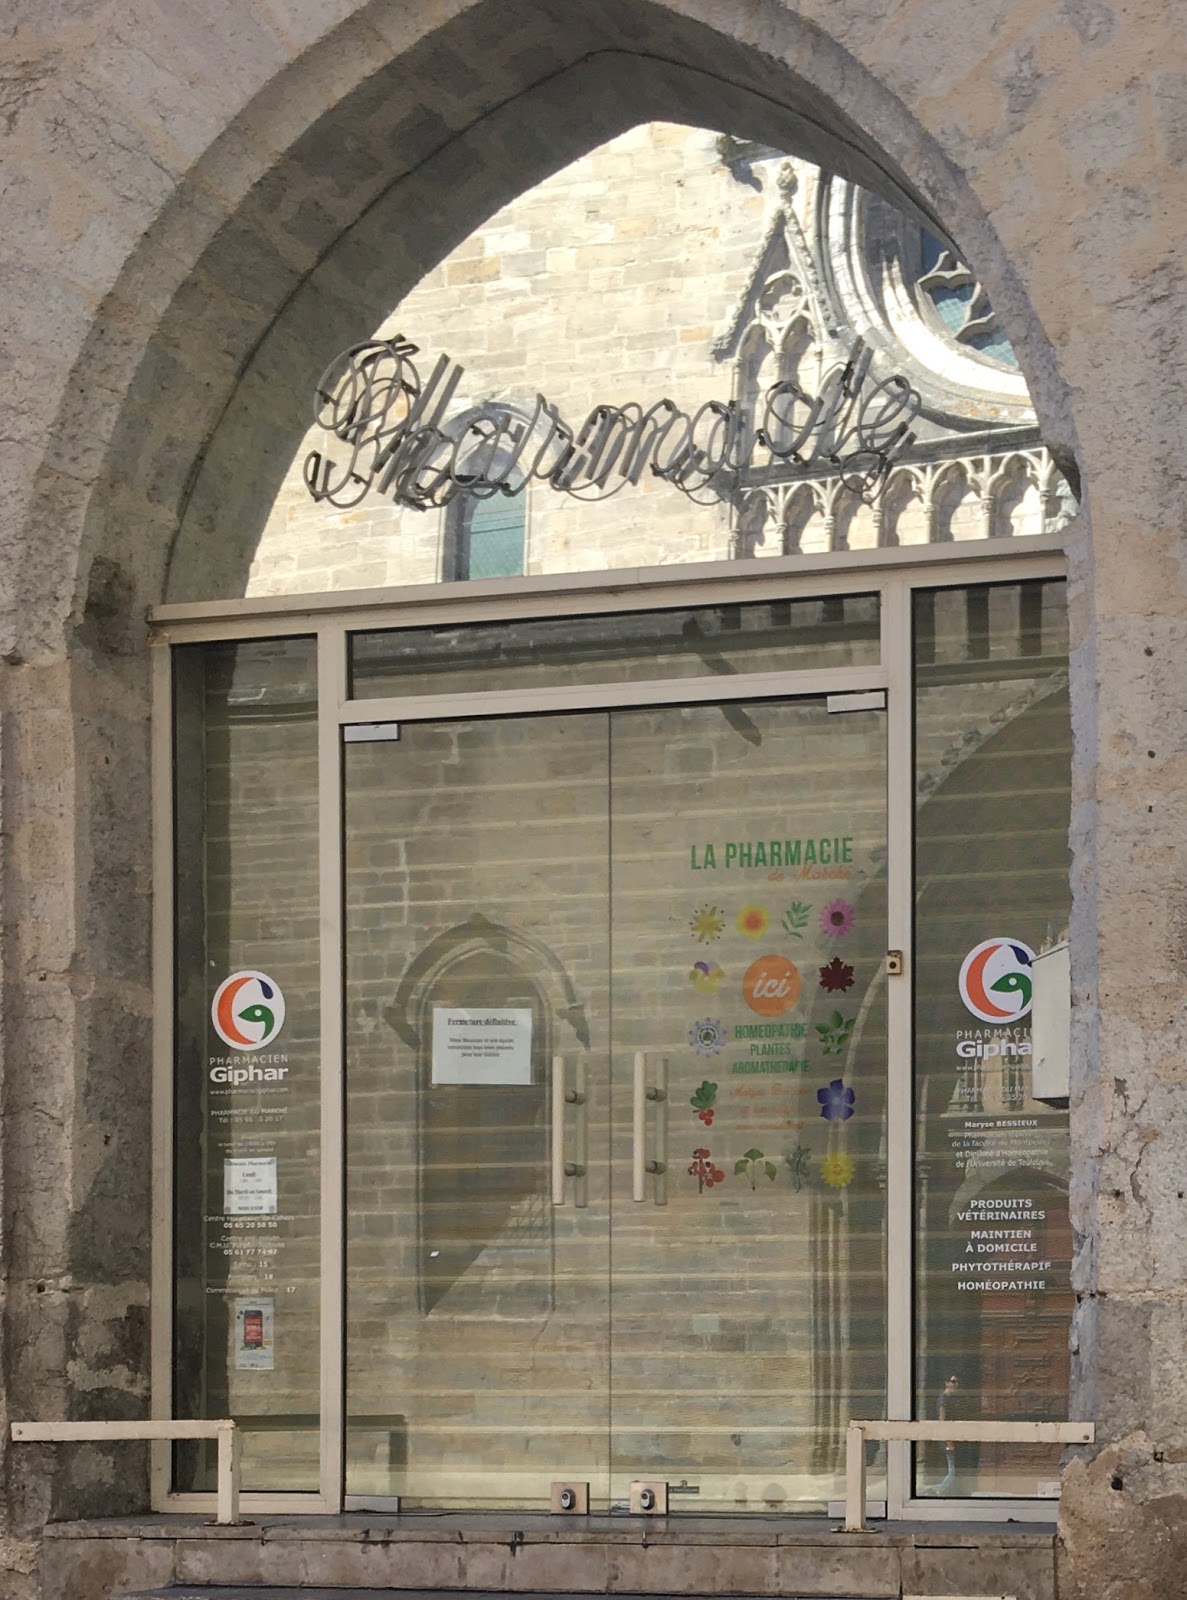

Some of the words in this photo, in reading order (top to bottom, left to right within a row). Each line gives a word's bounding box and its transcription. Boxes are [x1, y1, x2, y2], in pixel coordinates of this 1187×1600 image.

[303, 333, 920, 511] Pharmacie
[691, 844, 717, 870] LA
[725, 837, 854, 868] PHARMACIE
[752, 971, 791, 998] ici
[956, 1027, 1032, 1039] PHARMACI
[750, 1043, 791, 1056] PLANTES
[956, 1039, 1033, 1060] Gipha
[209, 1054, 288, 1066] PHARMACIEN
[210, 1065, 289, 1085] Giphar
[964, 1121, 995, 1129] Maryse
[996, 1119, 1038, 1127] BESSIEUX
[970, 1199, 1032, 1208] PRODUITS
[957, 1209, 1046, 1220] VÉTÉRINAIRES
[971, 1230, 1032, 1239] MAINTIEN
[965, 1242, 973, 1252] À
[977, 1243, 1037, 1252] DOMICILE
[952, 1260, 1052, 1271] PHYTOTHÉRAPIE
[958, 1279, 1046, 1290] HOMÉOPATHIE
